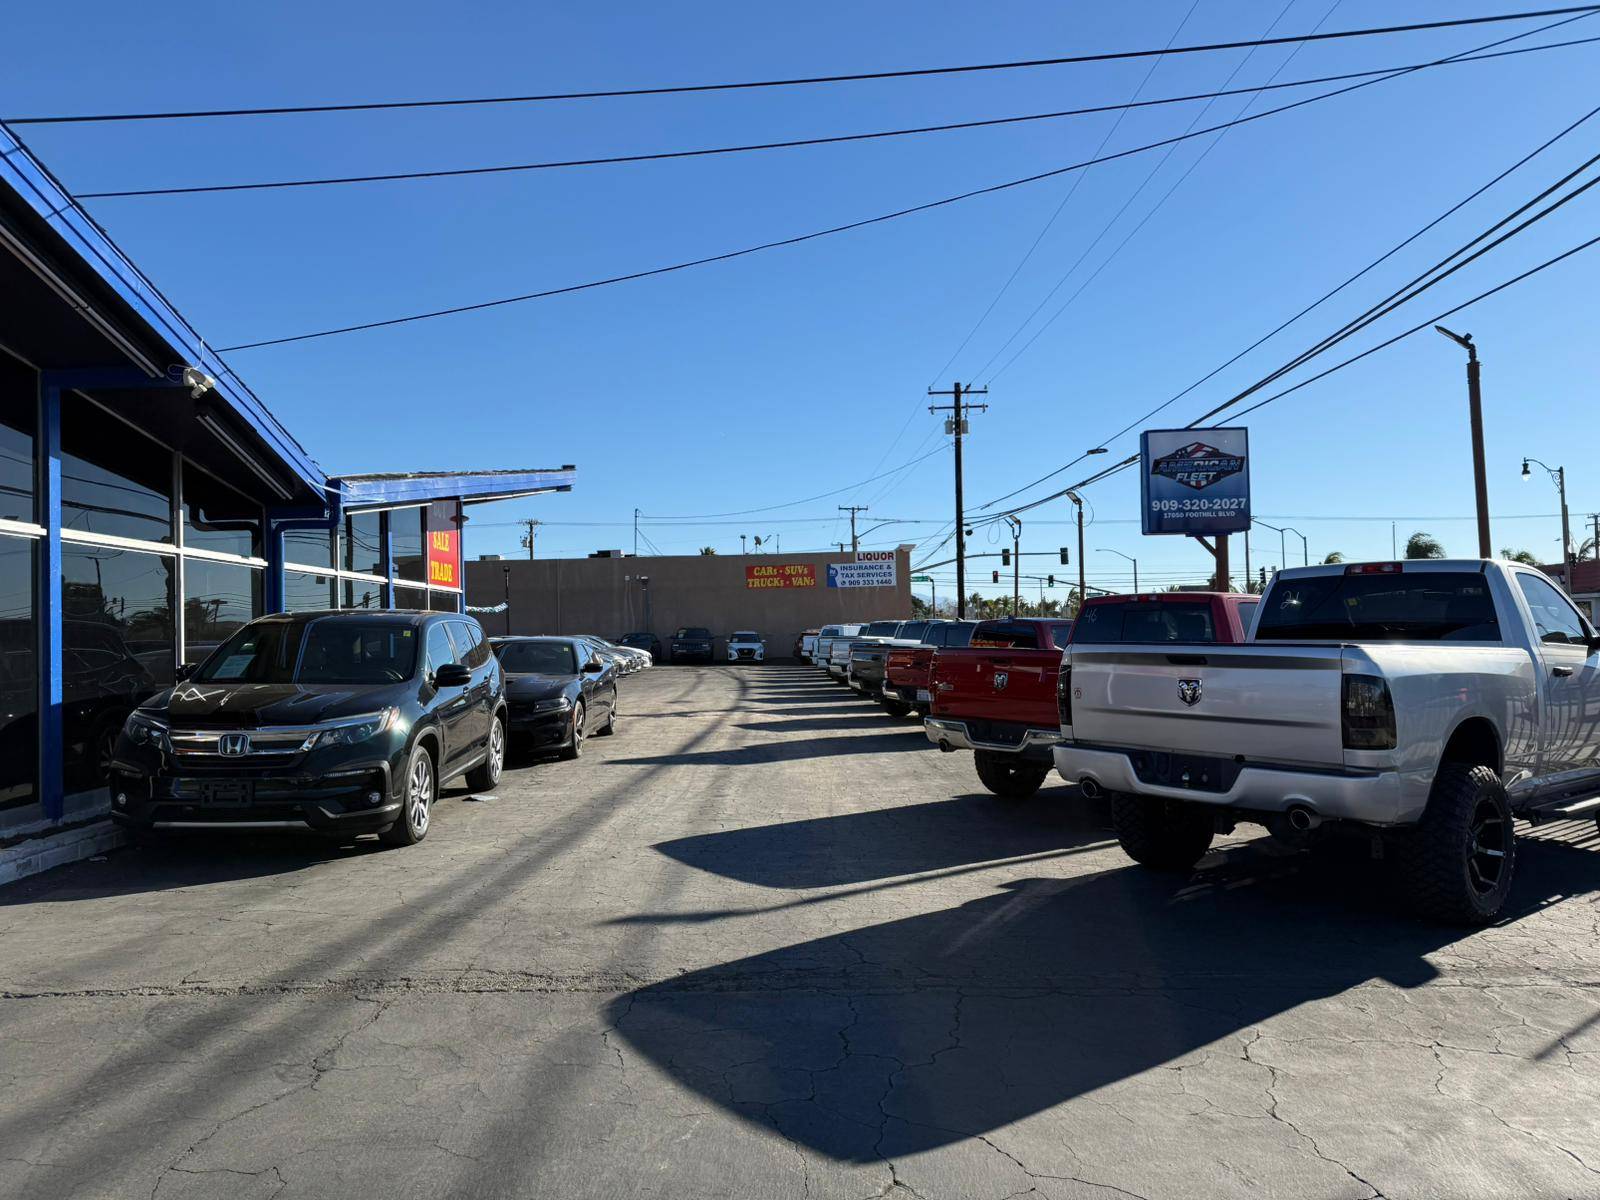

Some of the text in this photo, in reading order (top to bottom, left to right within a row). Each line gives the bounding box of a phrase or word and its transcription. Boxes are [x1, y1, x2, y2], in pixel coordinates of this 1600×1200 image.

[1176, 471, 1217, 481] FLEET
[1152, 498, 1247, 511] 909-320-2027
[433, 530, 450, 552] SALE
[857, 552, 894, 561] LIQUOR
[431, 560, 453, 582] TRADE
